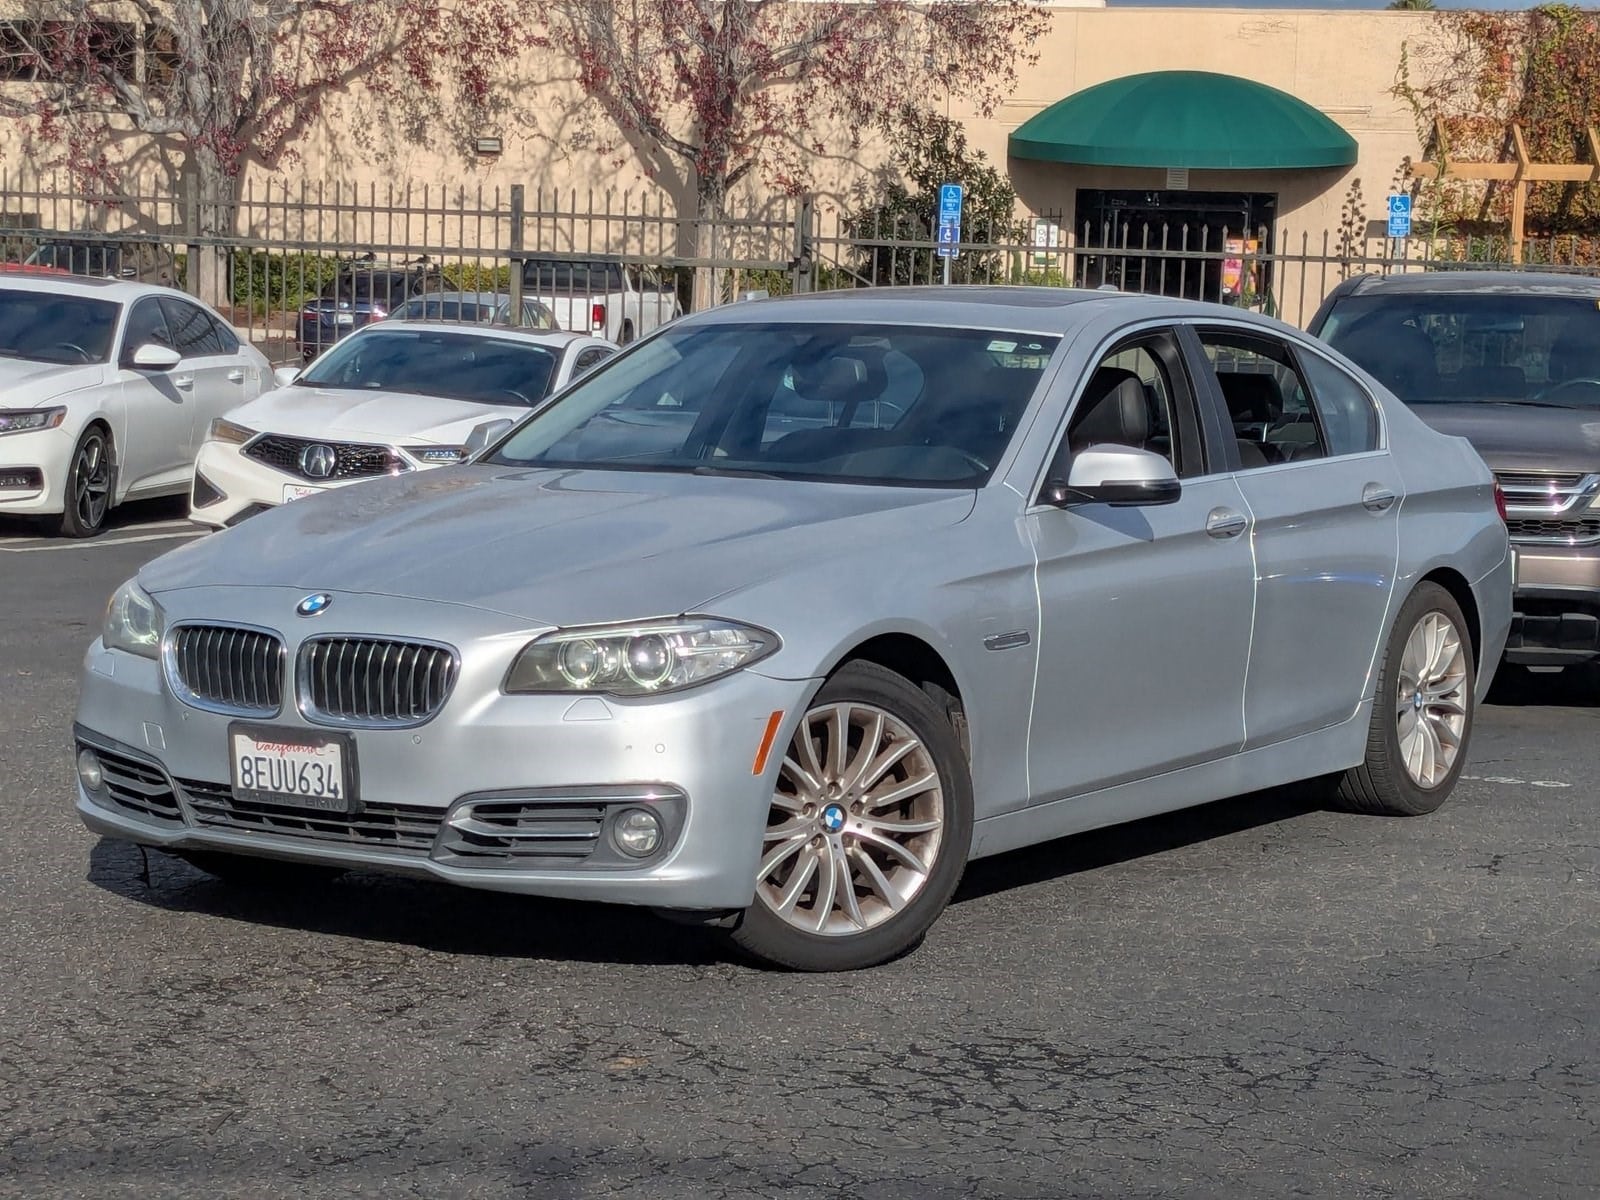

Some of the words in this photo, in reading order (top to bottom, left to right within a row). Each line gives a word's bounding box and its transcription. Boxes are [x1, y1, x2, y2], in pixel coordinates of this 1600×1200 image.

[254, 741, 325, 757] California
[240, 755, 340, 799] 8EUU634
[304, 797, 344, 809] BMW
